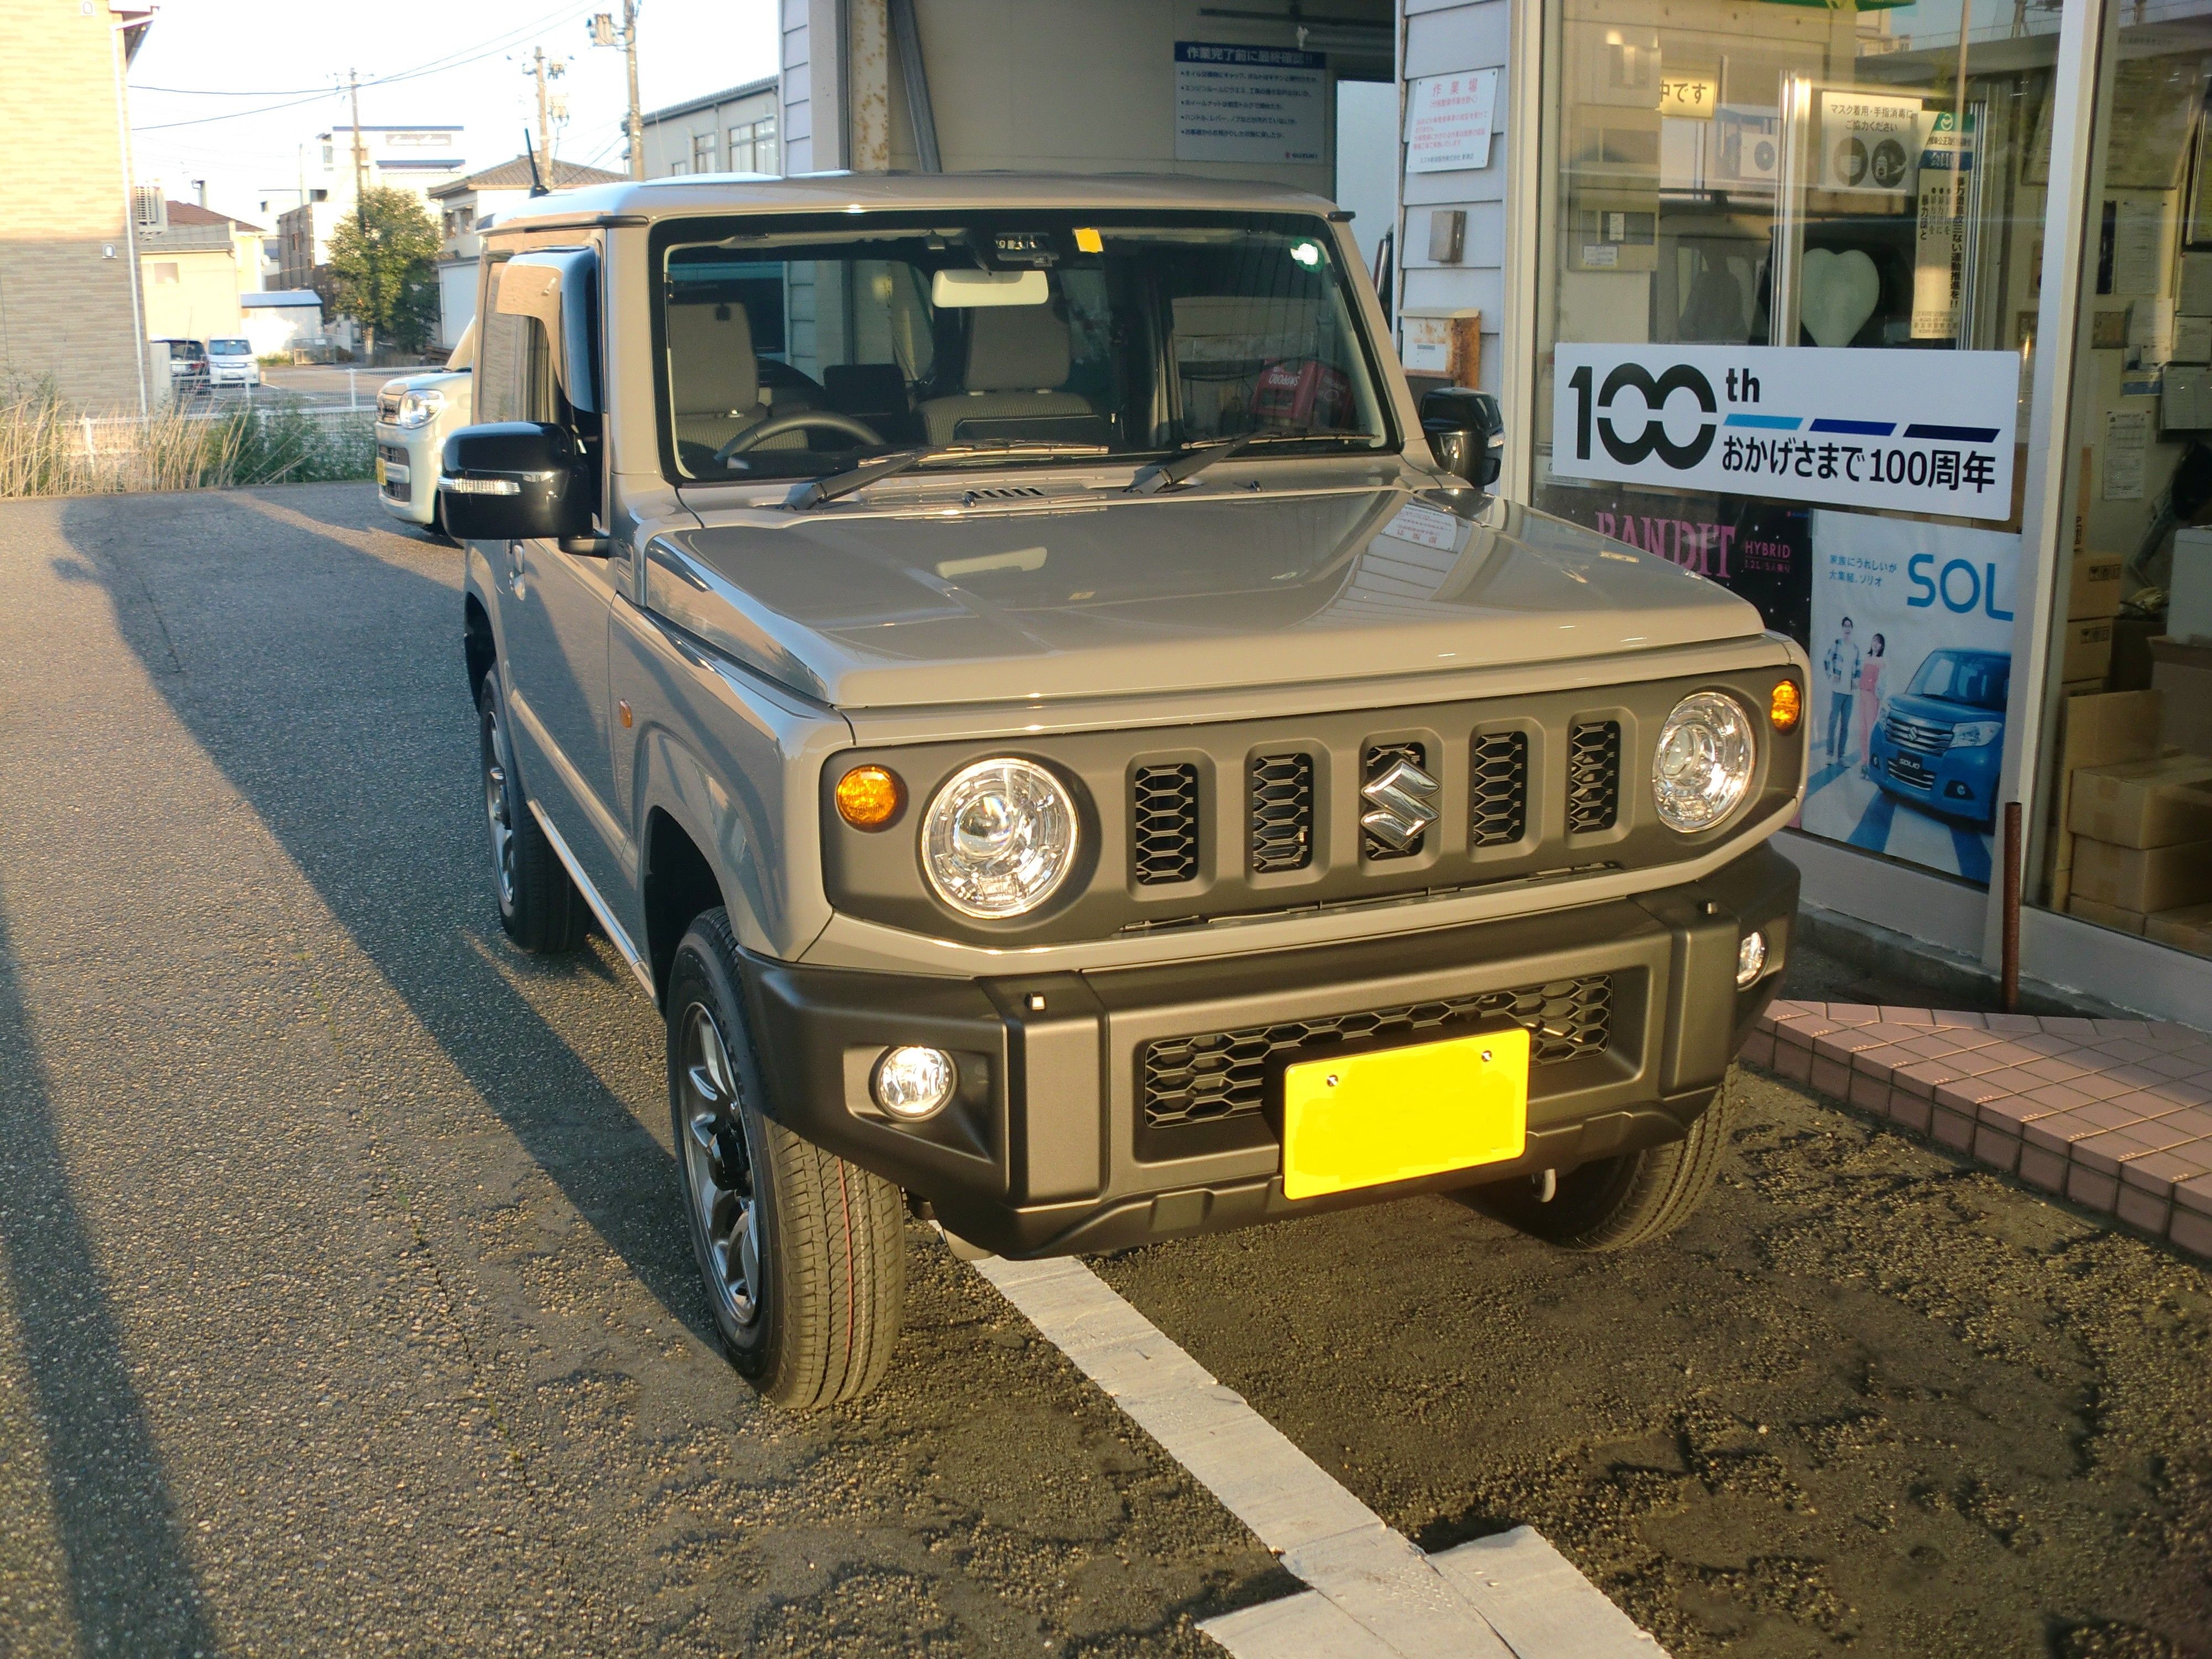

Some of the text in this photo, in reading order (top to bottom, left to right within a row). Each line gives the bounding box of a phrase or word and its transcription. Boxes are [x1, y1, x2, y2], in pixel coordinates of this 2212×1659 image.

[1845, 119, 1898, 132] ご協力ください
[1722, 435, 1996, 493] おかげさまで100周年
[1745, 540, 1791, 559] HYBRID
[1829, 554, 1897, 573] 家族にうれしいが
[1898, 758, 1921, 769] SOLIO
